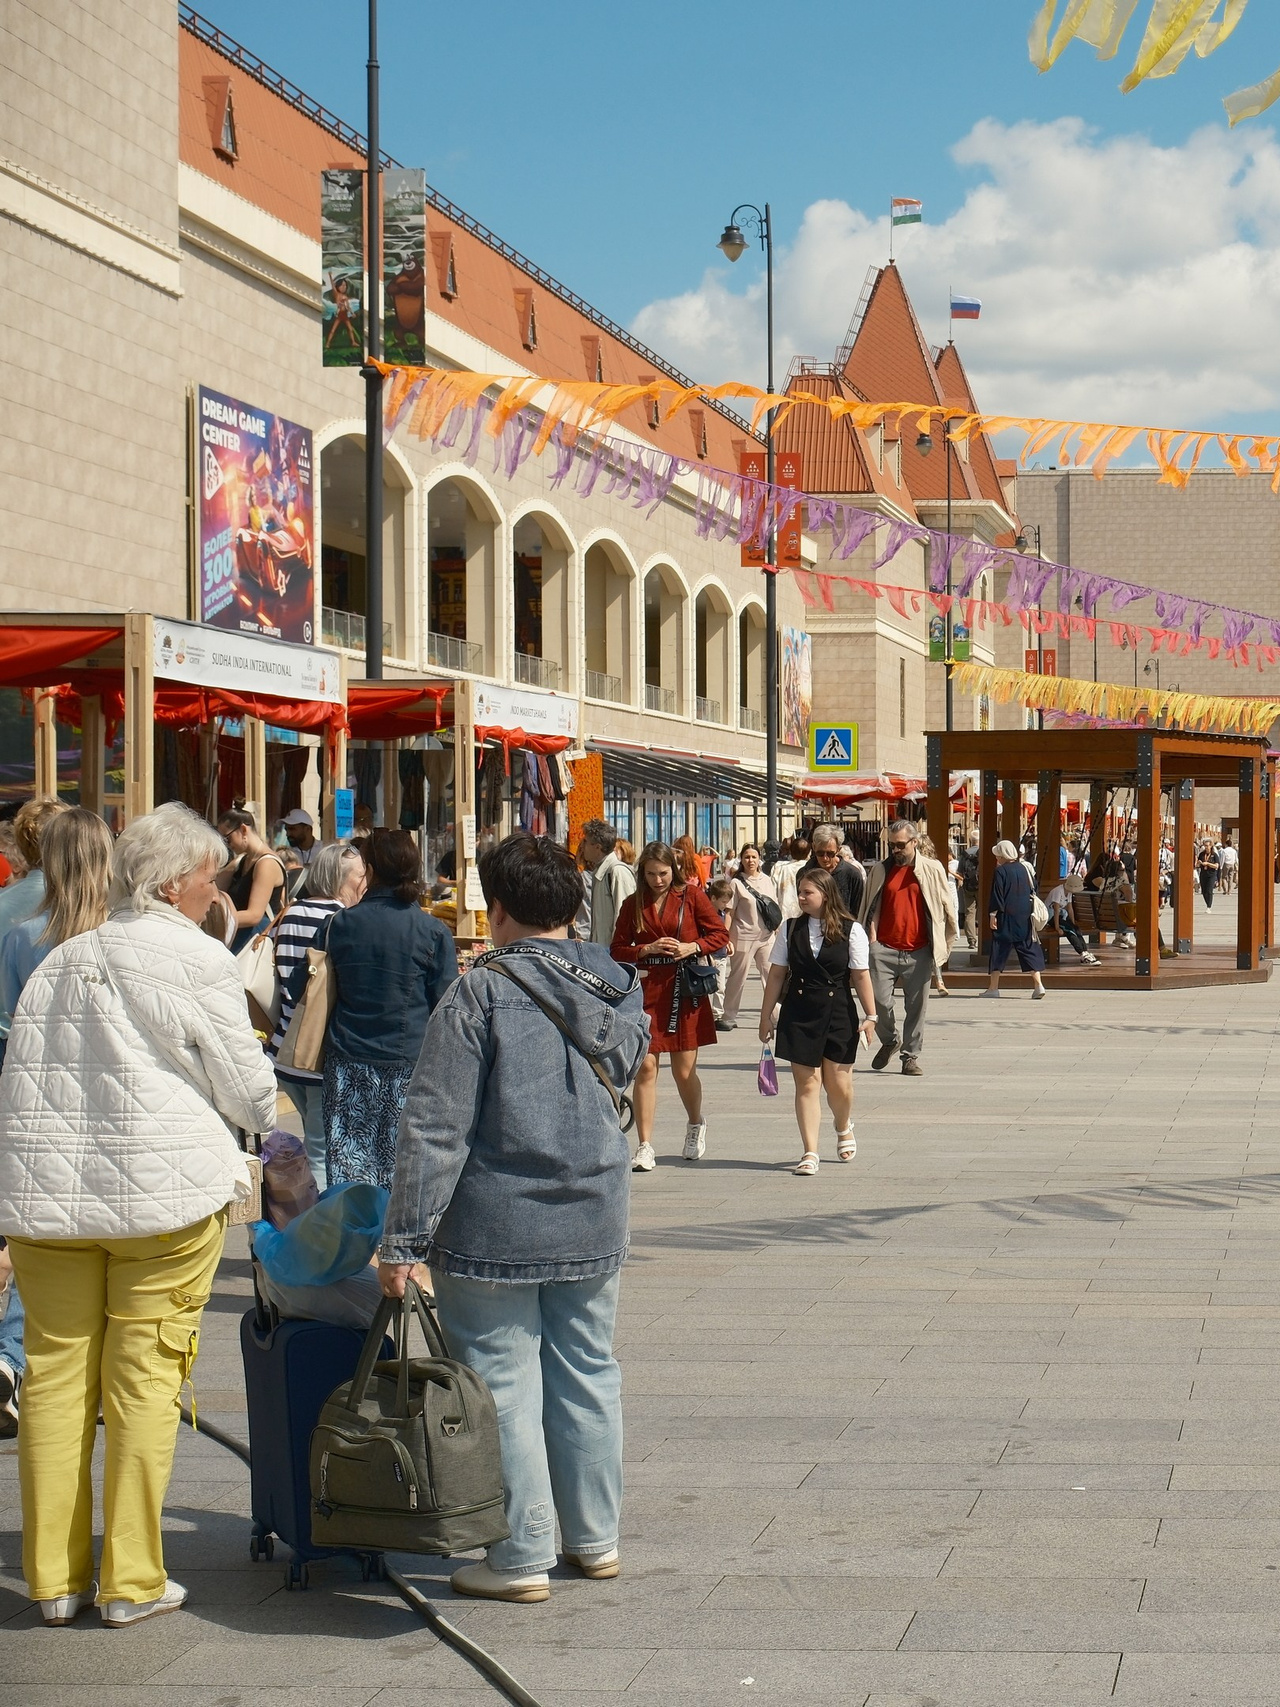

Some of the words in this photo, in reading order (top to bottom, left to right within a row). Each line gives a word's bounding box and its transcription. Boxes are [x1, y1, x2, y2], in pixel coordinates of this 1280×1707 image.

[202, 396, 238, 428] DREAM
[239, 411, 266, 438] GAME
[202, 422, 240, 452] CENTER
[204, 526, 232, 559] БОЛЕЕ
[204, 547, 233, 592] 300
[211, 652, 231, 667] SUDHA
[233, 656, 248, 670] INDIA
[250, 659, 292, 677] INTERNATIONAL
[575, 968, 602, 987] TONG
